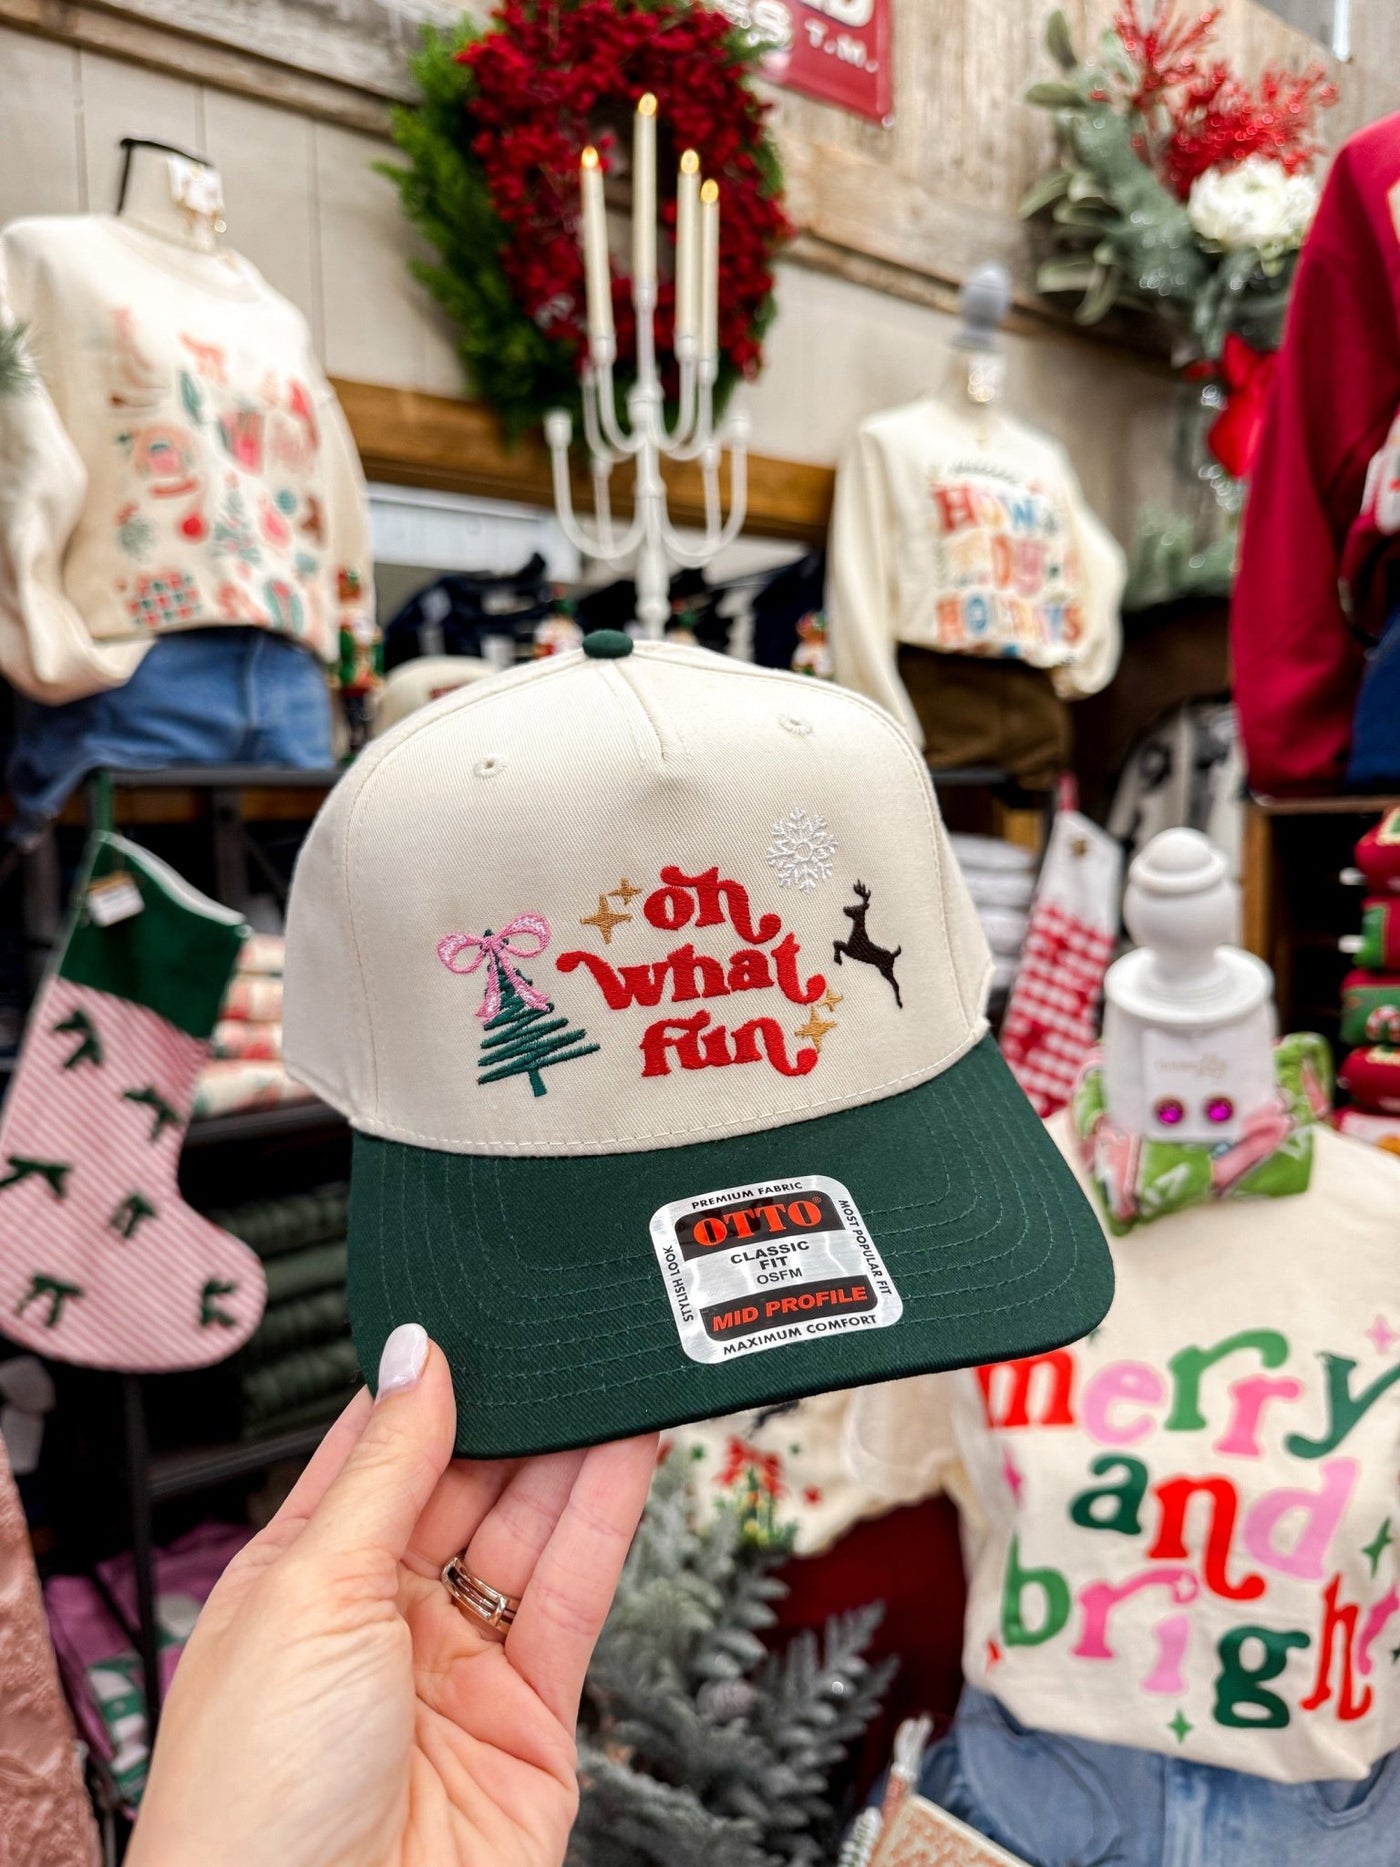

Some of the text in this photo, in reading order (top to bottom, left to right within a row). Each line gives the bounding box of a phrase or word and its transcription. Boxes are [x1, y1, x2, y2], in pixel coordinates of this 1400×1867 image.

[643, 865, 782, 945] oh
[555, 932, 827, 1010] what
[639, 1009, 818, 1077] fun
[691, 1182, 803, 1210] PREMIUM FABRIC
[730, 1241, 810, 1264] CLASSIC
[756, 1268, 803, 1285] OSFM
[759, 1256, 788, 1270] FIT
[838, 1200, 892, 1295] MOST POPULAR FIT
[663, 1245, 694, 1322] STYLISH LOOK
[713, 1286, 868, 1332] MID PROFILE
[724, 1315, 877, 1355] MAXIMUM COMFORT
[974, 1328, 1400, 1460] merry
[1068, 1452, 1360, 1602] and
